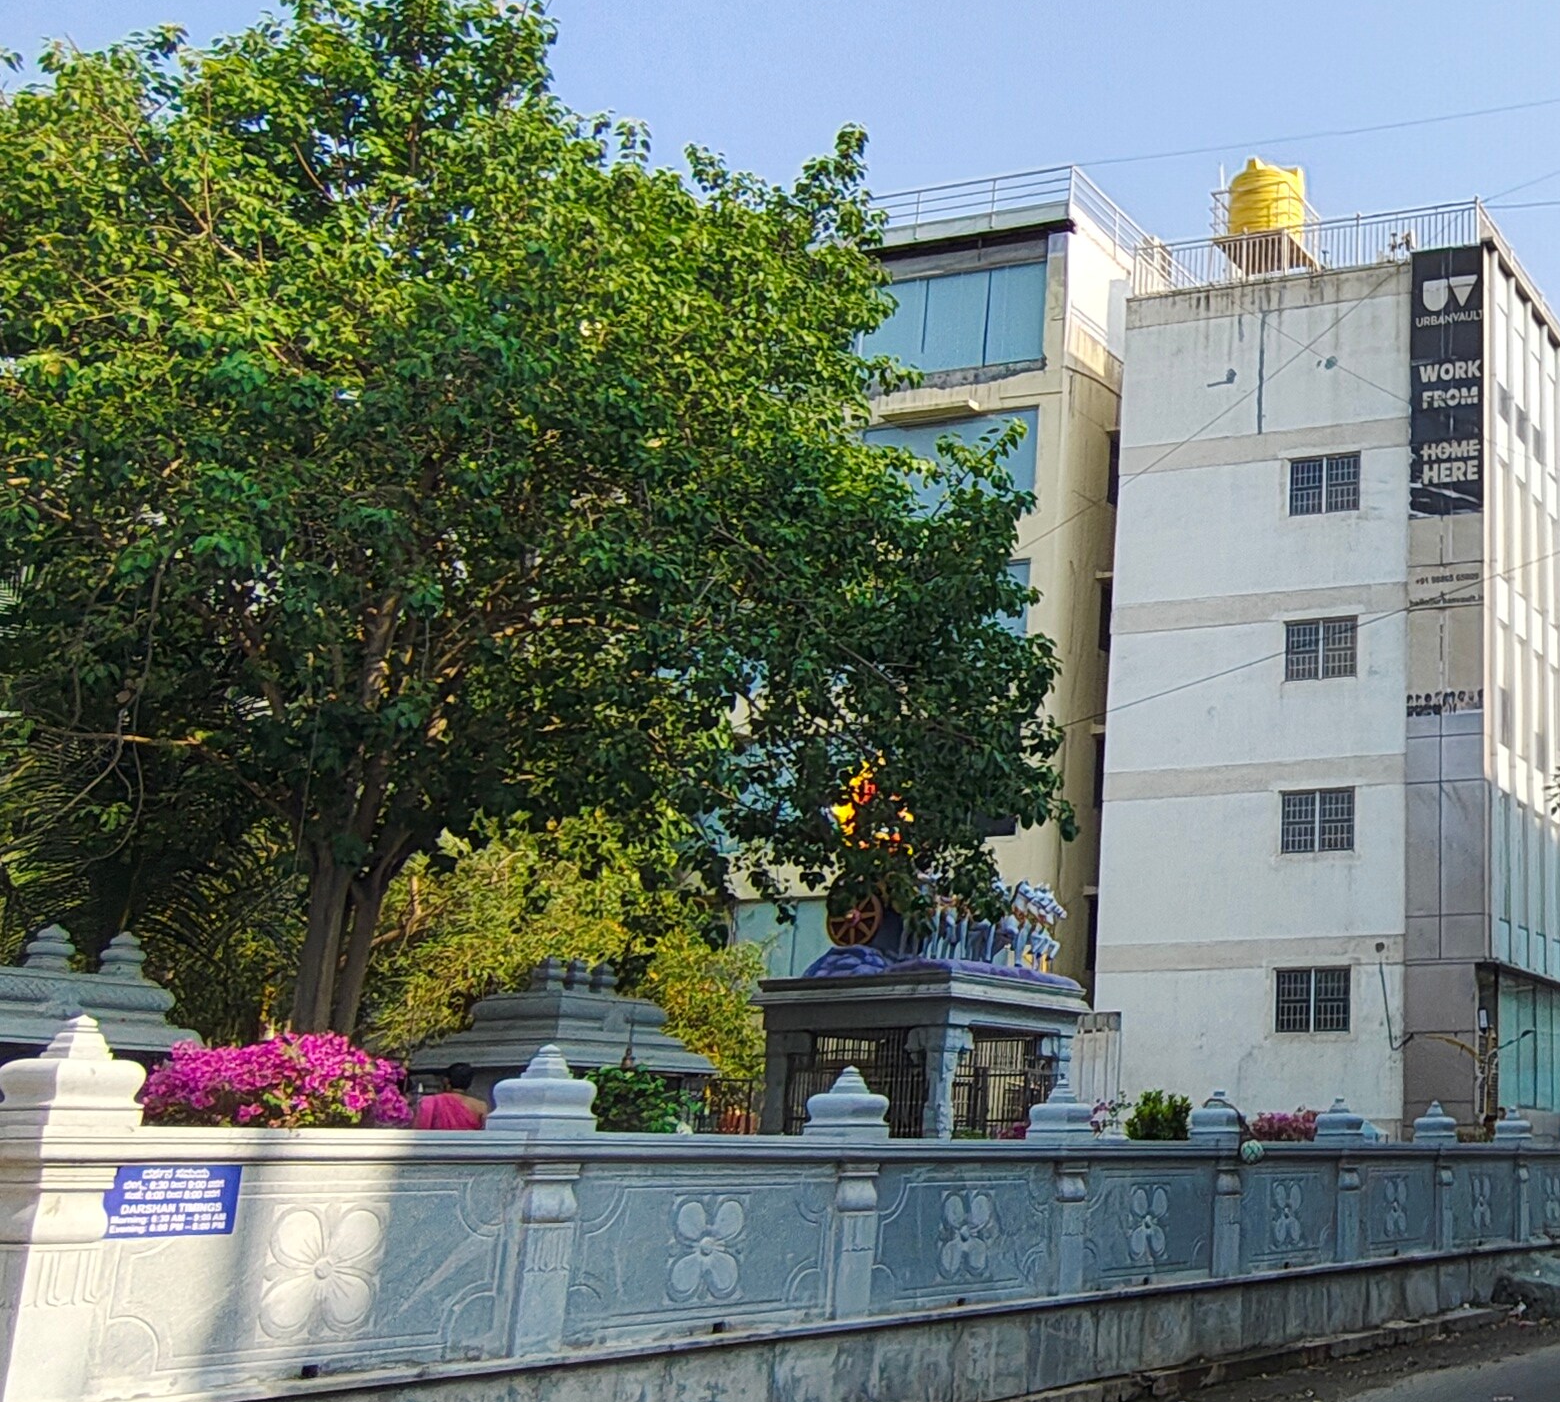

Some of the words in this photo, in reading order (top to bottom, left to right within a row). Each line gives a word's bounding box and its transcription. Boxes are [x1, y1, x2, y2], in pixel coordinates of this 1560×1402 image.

[1419, 359, 1481, 383] WORK
[1422, 386, 1479, 410] FROM
[1421, 439, 1480, 462] HOME
[1422, 460, 1479, 486] HERE
[120, 1203, 176, 1215] DARSHAN
[179, 1202, 222, 1213] TIMINGS
